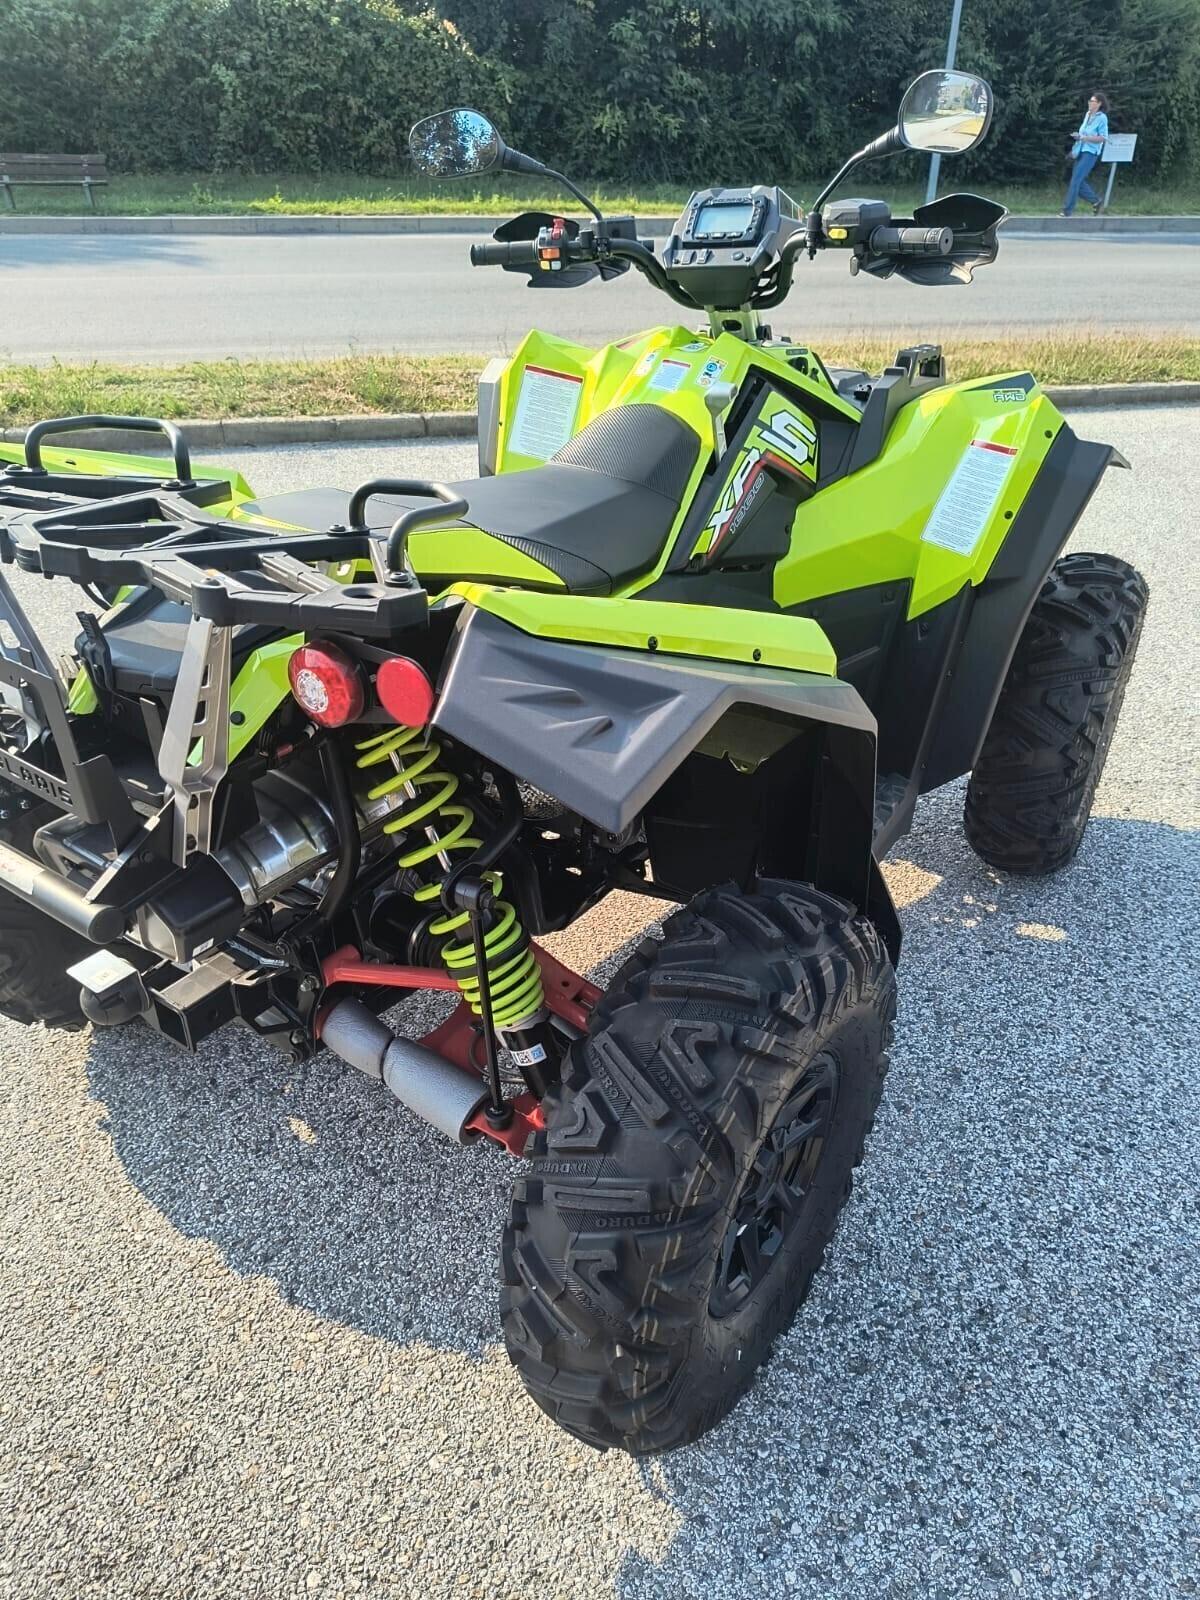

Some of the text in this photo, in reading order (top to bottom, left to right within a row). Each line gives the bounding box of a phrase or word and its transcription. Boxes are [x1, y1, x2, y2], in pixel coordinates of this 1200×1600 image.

[993, 393, 1026, 402] AWD
[706, 448, 760, 552] XP
[758, 410, 817, 466] S
[729, 472, 765, 534] 1000
